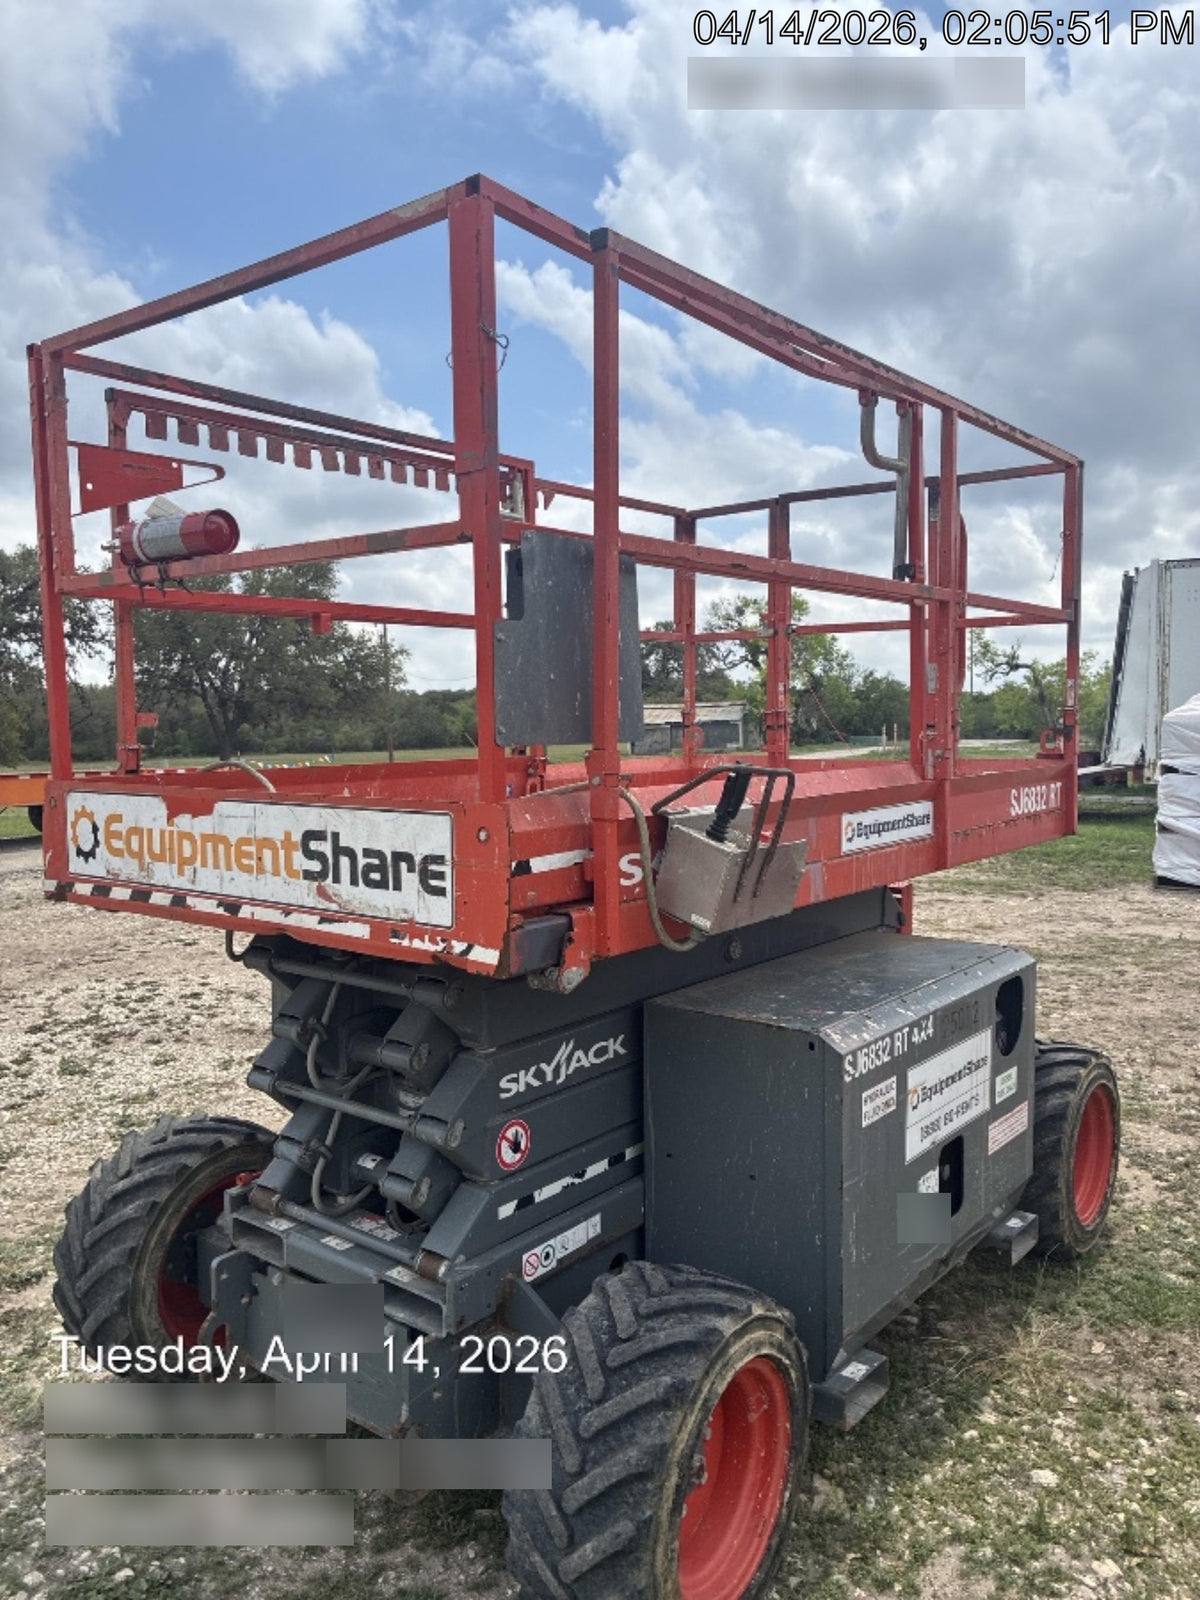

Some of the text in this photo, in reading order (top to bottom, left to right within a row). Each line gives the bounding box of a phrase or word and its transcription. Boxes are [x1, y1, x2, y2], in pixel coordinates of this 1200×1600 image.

[856, 813, 931, 840] EquipmentShare
[1010, 781, 1062, 817] SJ6832 RT
[103, 813, 447, 897] EquipmentShare
[499, 1034, 628, 1099] SKYJACK
[843, 1036, 892, 1083] SJ6832
[893, 1026, 909, 1057] RT
